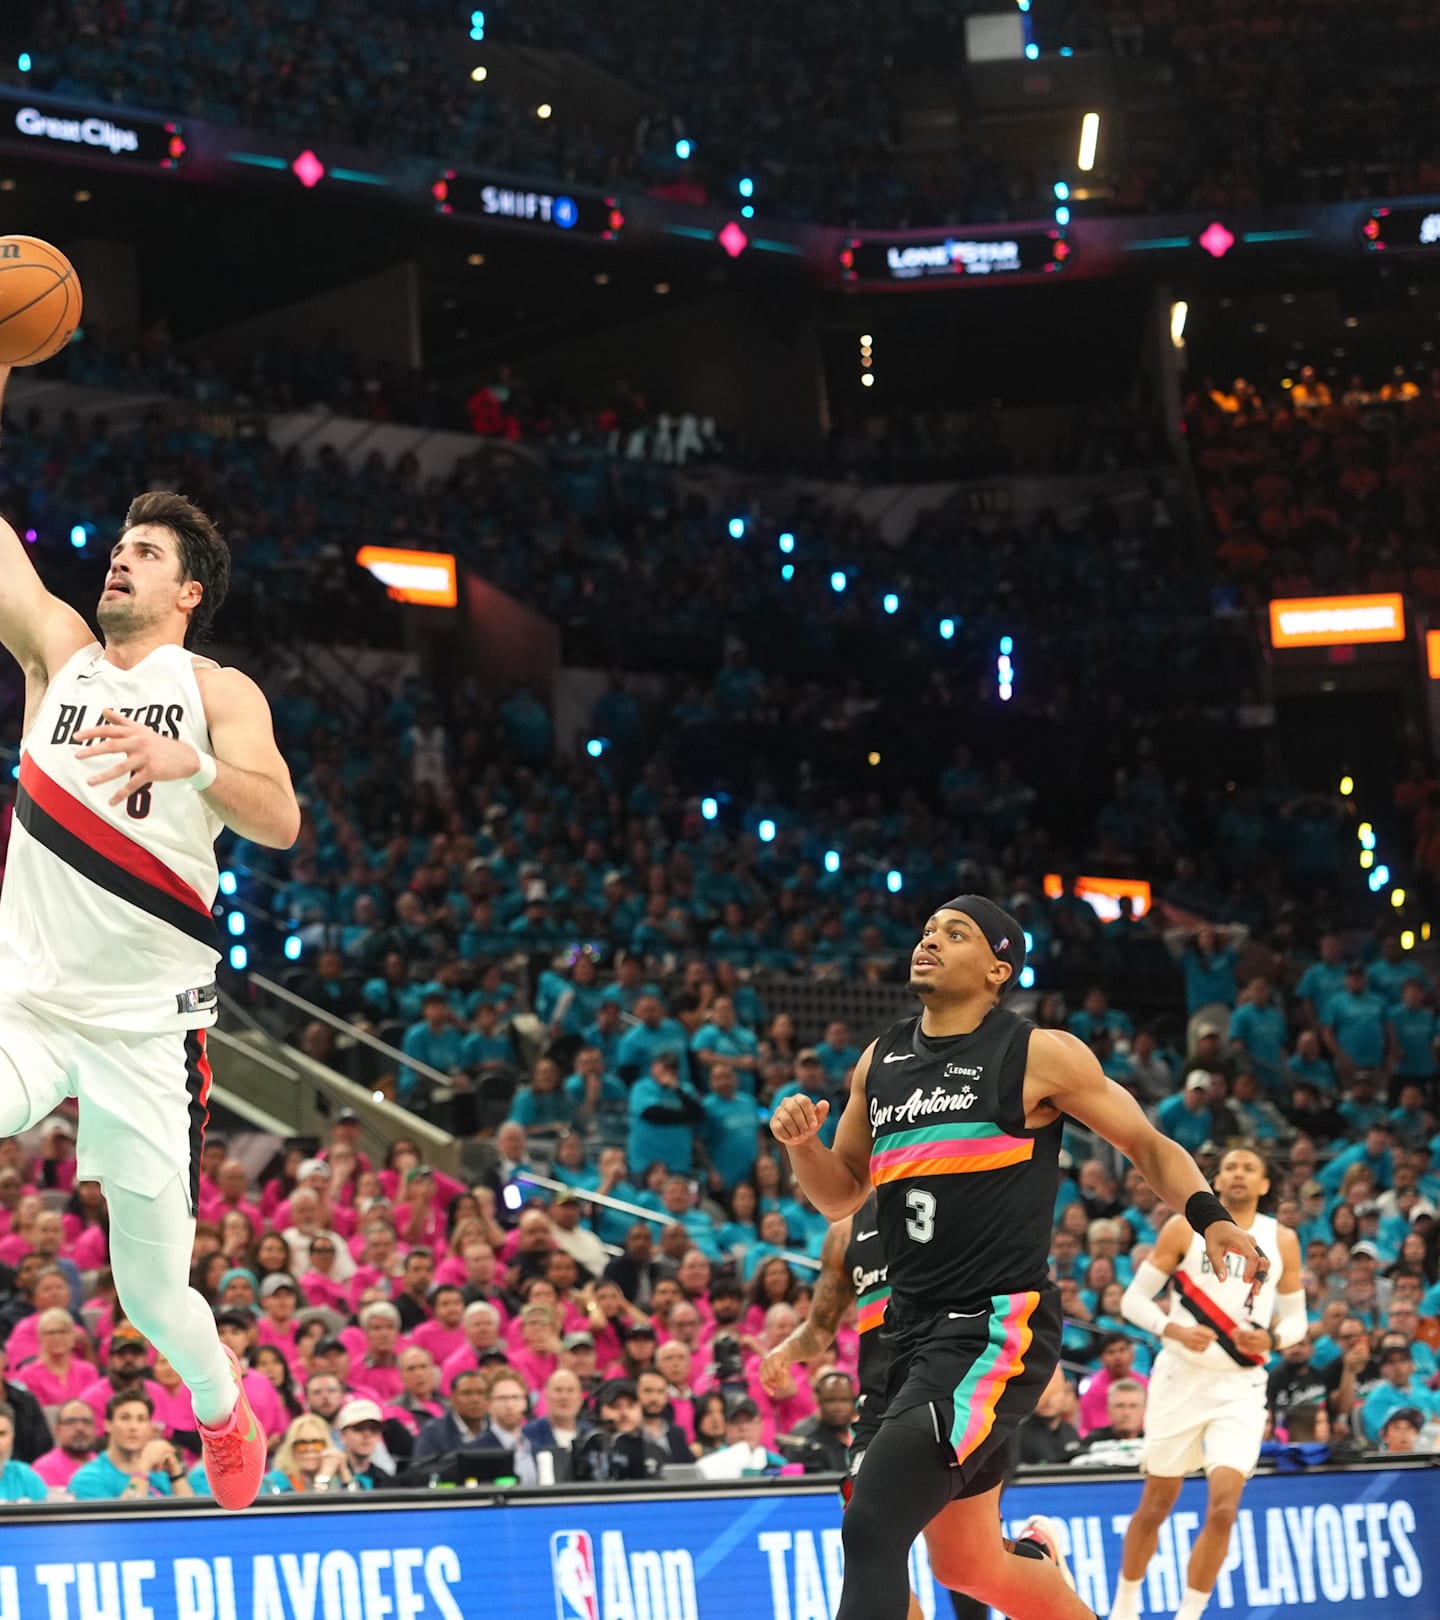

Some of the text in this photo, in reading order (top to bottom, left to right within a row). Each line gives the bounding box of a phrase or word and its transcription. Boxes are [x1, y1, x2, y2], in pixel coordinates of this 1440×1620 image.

[948, 1066, 977, 1077] LEDGER
[869, 1085, 978, 1138] San Antonio
[905, 1188, 937, 1244] 3
[1215, 1499, 1424, 1609] PLAYOFFS
